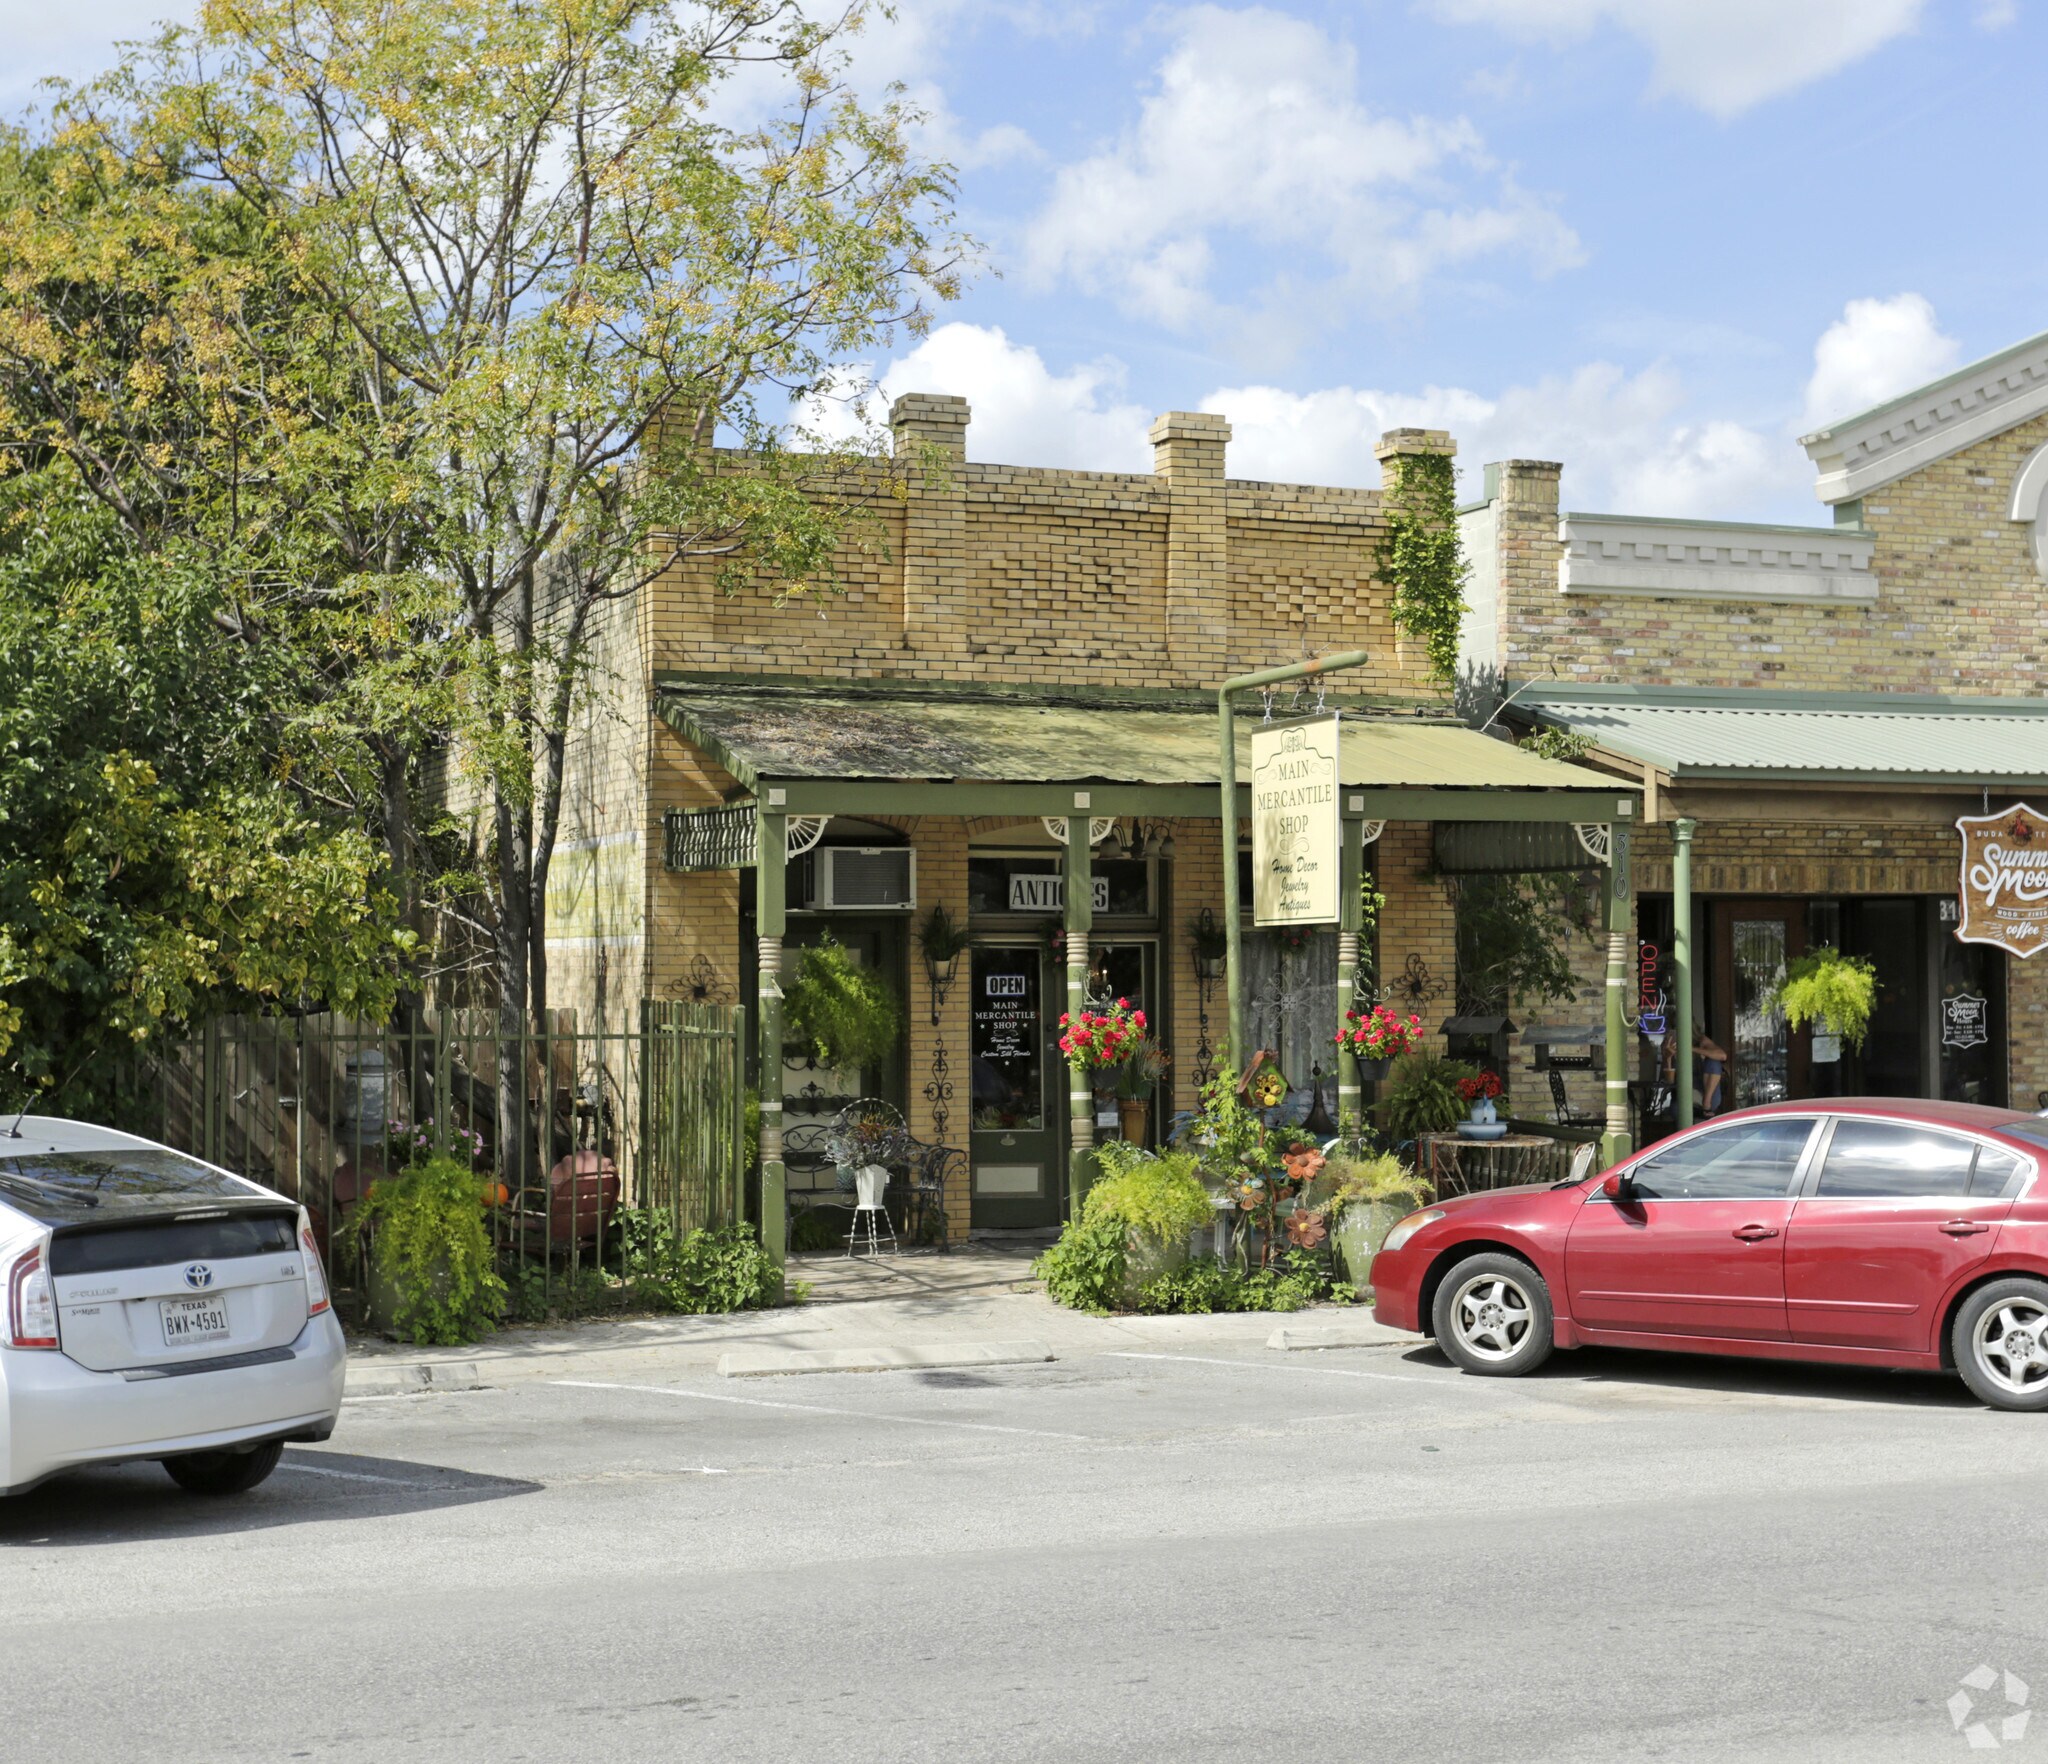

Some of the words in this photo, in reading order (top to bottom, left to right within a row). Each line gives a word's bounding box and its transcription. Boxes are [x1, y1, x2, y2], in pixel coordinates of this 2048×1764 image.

[1278, 759, 1309, 781] MAIN
[1257, 783, 1332, 811] MERCANTILE
[1279, 814, 1309, 835] SHOP
[1976, 830, 2004, 838] BUDA
[1271, 858, 1293, 875] Home
[1296, 856, 1319, 873] Decor
[1614, 832, 1628, 899] 310
[1011, 879, 1107, 908] ANTIS
[1280, 876, 1309, 897] Jewelry
[1278, 895, 1311, 916] Antiques
[1940, 900, 1961, 920] 31
[1997, 909, 2018, 918] WOOD
[2006, 921, 2040, 939] coffee
[989, 977, 1023, 994] OPEN
[1641, 945, 1659, 1010] OPEN
[993, 1001, 1018, 1010] MAIN
[1948, 1001, 1980, 1017] Summer
[975, 1011, 1036, 1020] MERCANTILE
[993, 1021, 1018, 1030] SHOP
[181, 1301, 207, 1311] TEXAS
